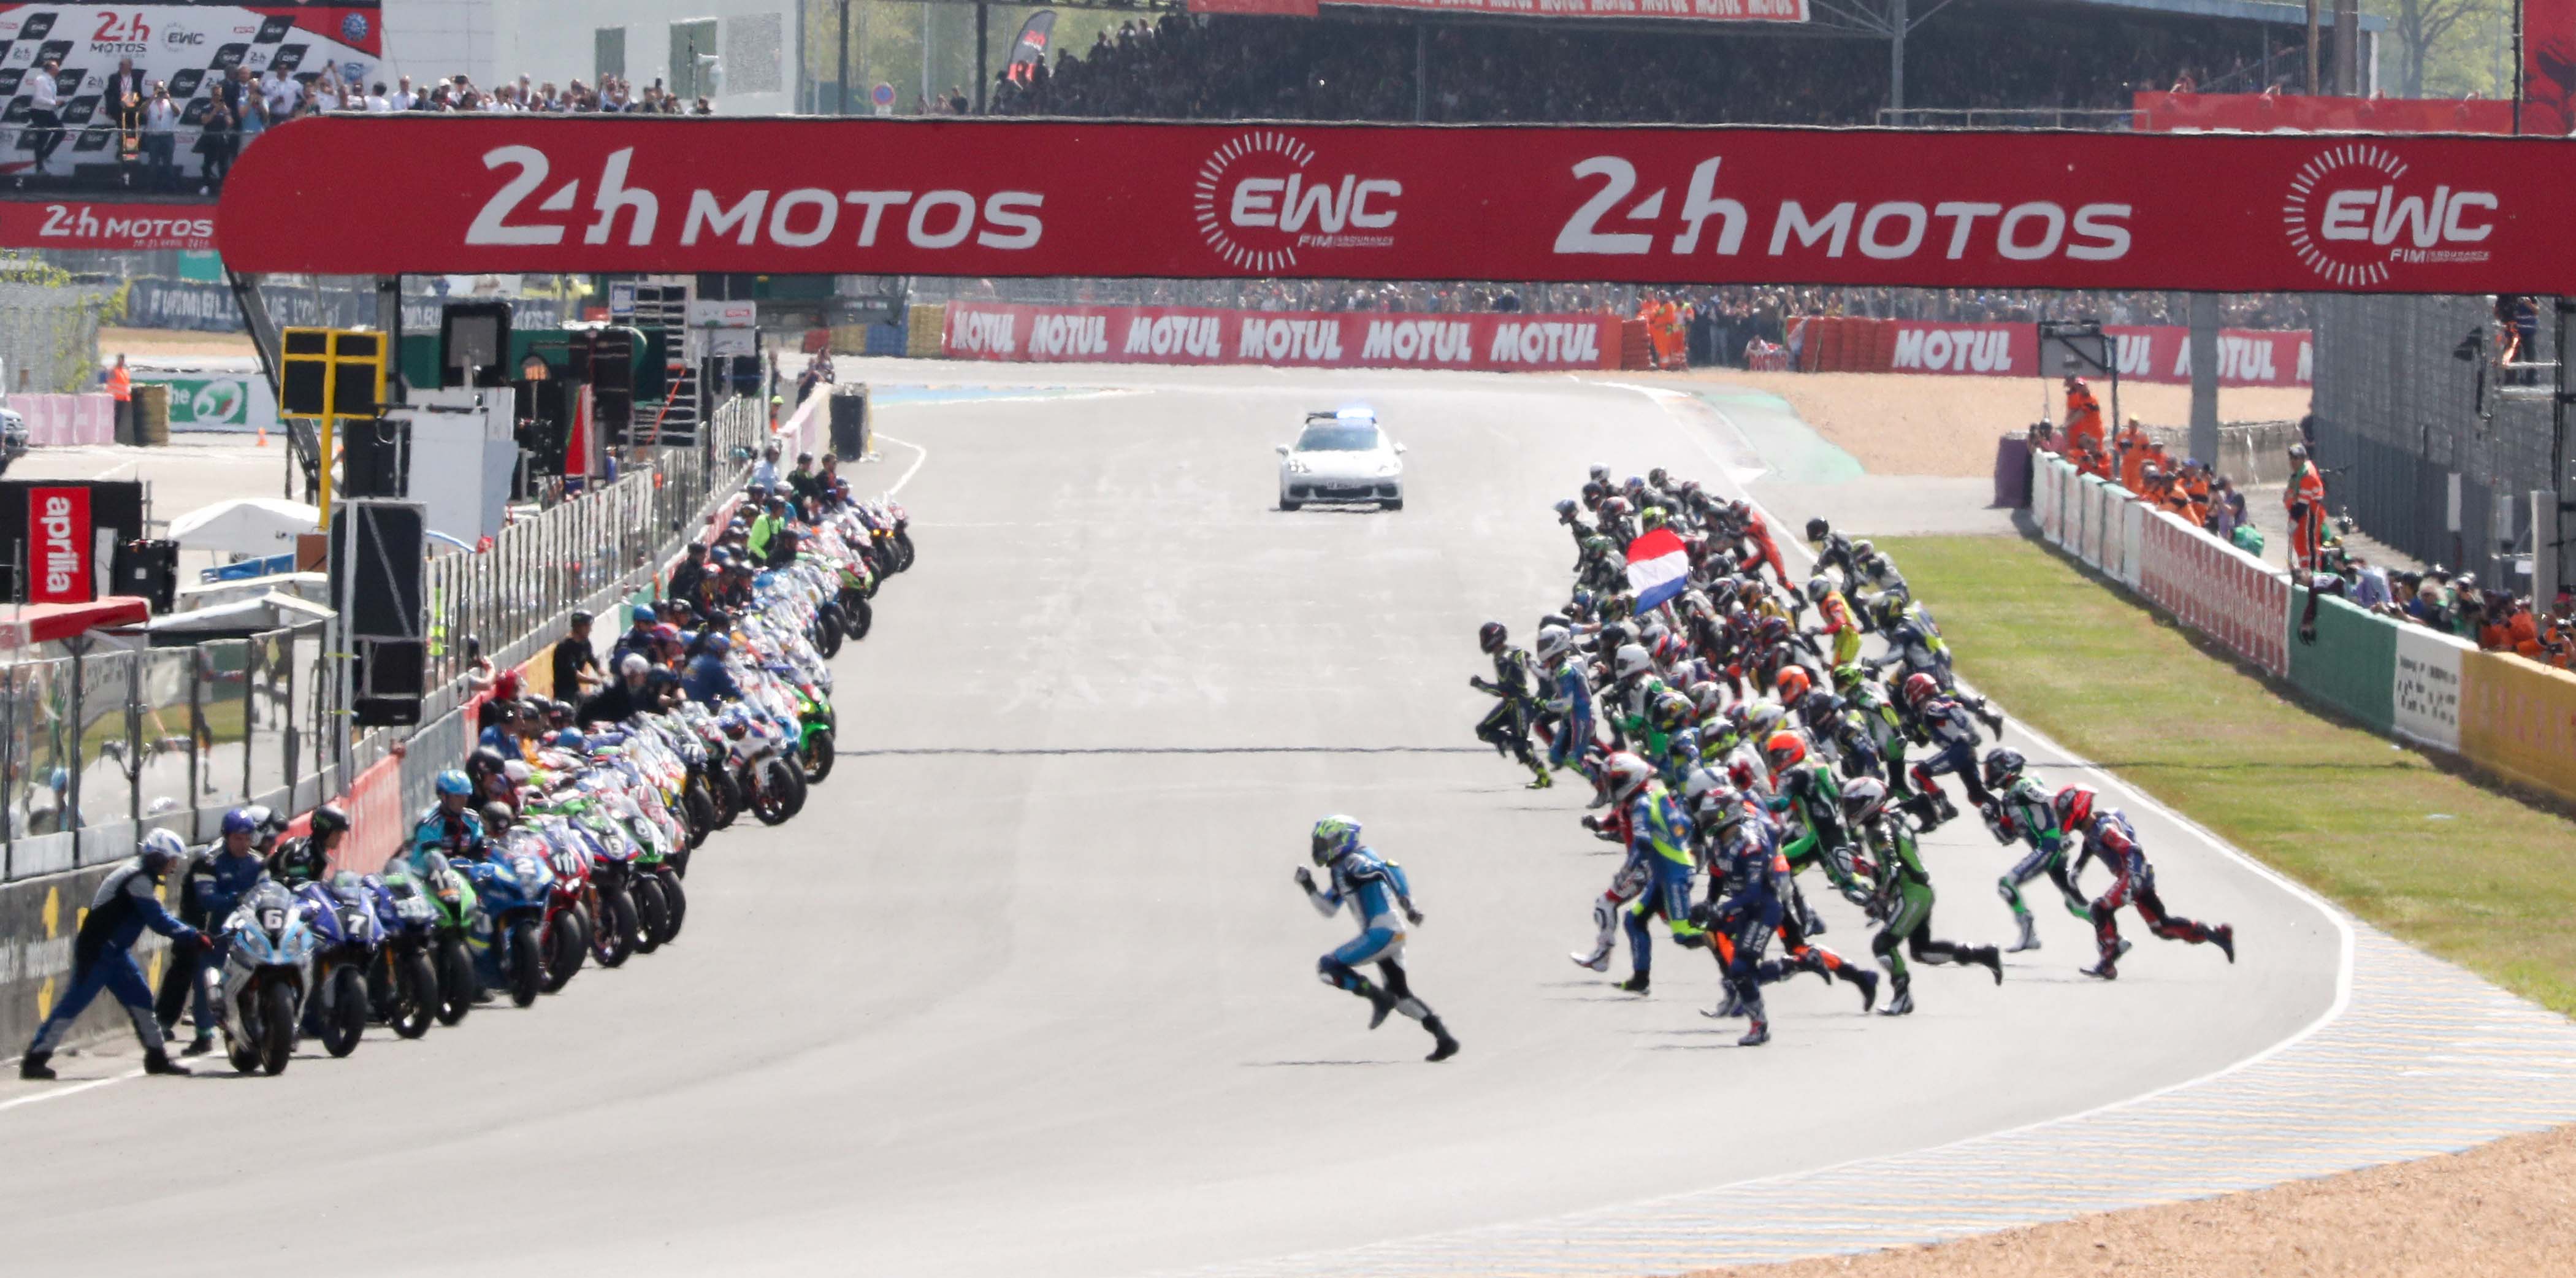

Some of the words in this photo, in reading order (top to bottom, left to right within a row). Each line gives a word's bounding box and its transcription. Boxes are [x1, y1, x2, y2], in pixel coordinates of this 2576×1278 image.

[93, 12, 151, 42] 24h
[167, 32, 205, 45] EWC
[90, 42, 147, 52] MOTOS
[465, 145, 659, 245] 24h
[681, 188, 1044, 249] MOTOS
[1231, 173, 1402, 233] EWC
[1553, 155, 1748, 255] 24h
[1768, 199, 2132, 261] MOTOS
[40, 205, 99, 237] 24h
[104, 219, 213, 237] MOTOS
[2322, 185, 2498, 247] EWC
[1298, 235, 1334, 247] FIM
[2390, 248, 2426, 262] FIM
[951, 311, 1015, 353] MOTUL
[1028, 314, 1108, 354] MOTUL
[1123, 316, 1221, 357] MOTUL
[1239, 318, 1343, 359] MOTUL
[1363, 320, 1471, 361] MOTUL
[1490, 323, 1599, 363] MOTUL
[1892, 329, 2012, 372] MOTUL
[40, 496, 79, 593] aprilia
[264, 909, 283, 929] 6
[346, 914, 367, 934] 7
